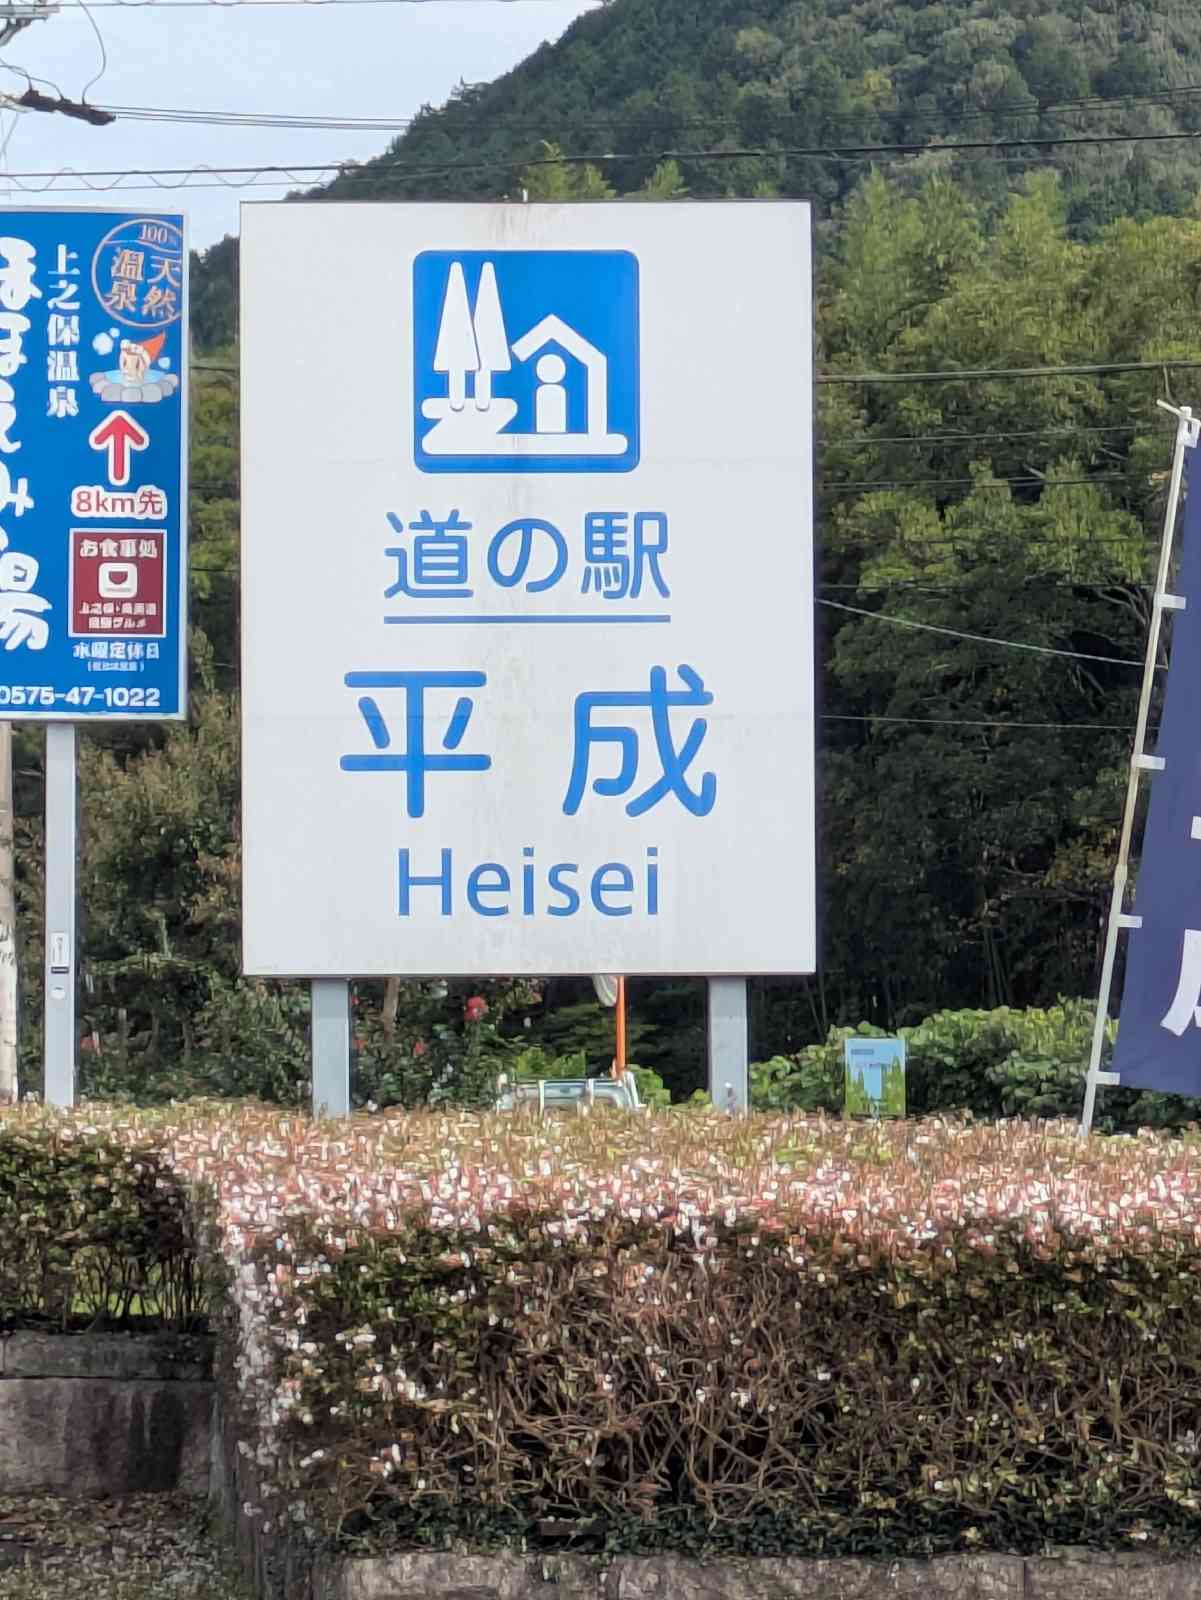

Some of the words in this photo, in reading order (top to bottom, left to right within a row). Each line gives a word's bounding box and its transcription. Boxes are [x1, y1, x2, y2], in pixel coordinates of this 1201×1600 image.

[47, 244, 80, 418] 上之保温泉
[75, 489, 164, 515] 8km先
[384, 509, 671, 599] 道の駅
[340, 664, 717, 818] 平成
[398, 847, 658, 917] Heisei
